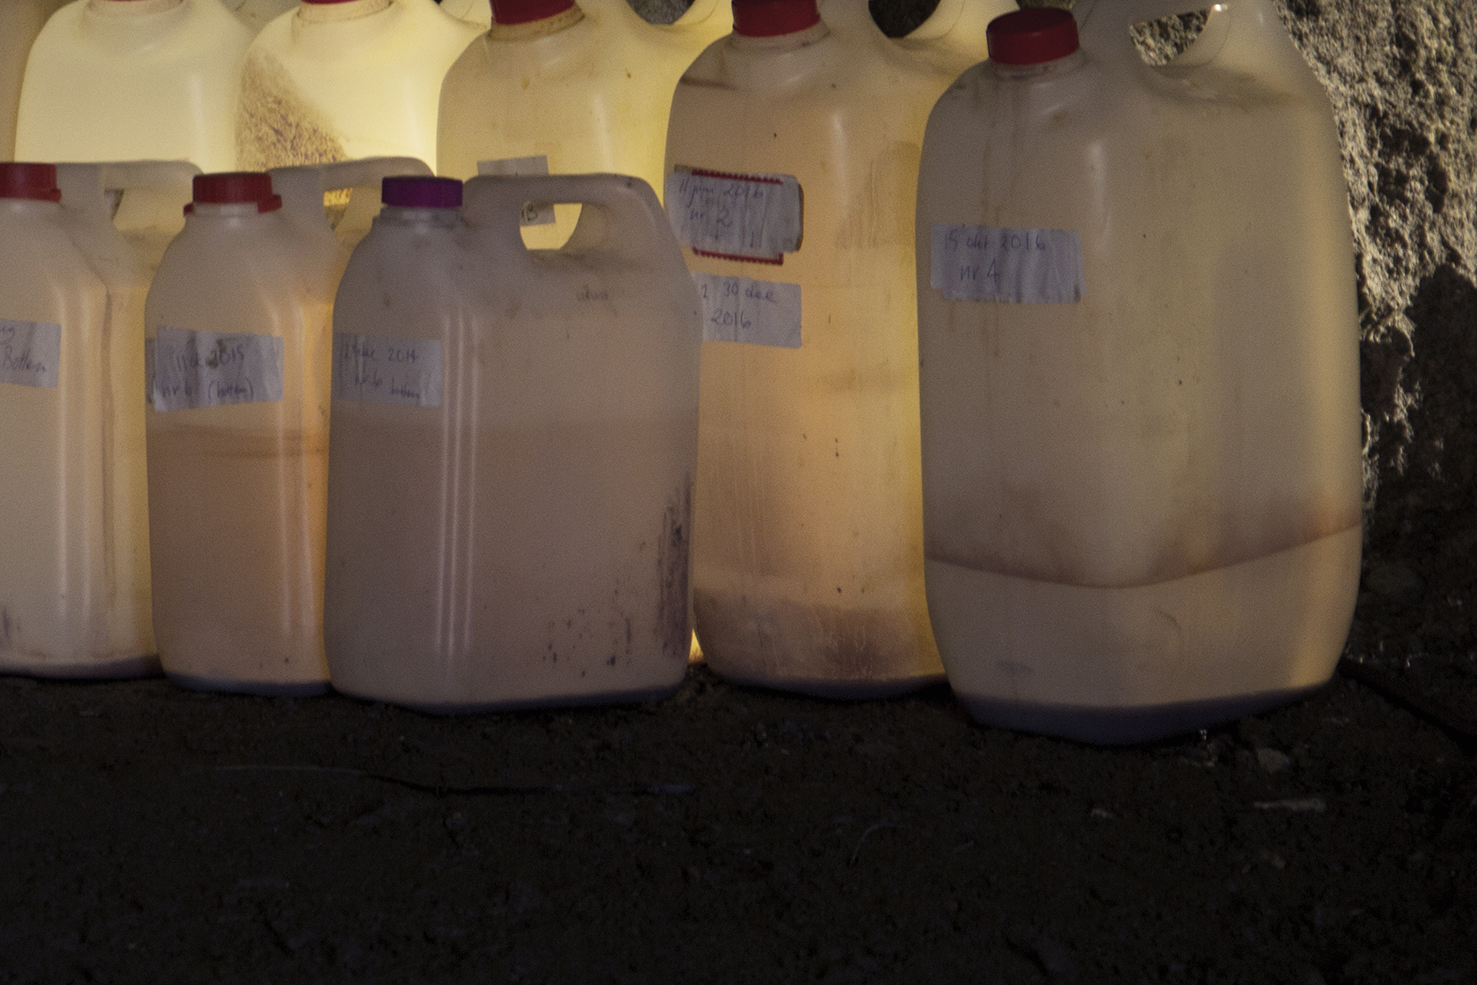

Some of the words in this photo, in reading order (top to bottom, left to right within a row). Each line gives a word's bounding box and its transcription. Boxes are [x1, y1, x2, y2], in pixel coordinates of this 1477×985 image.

[1001, 233, 1046, 251] 2016
[986, 258, 998, 283] 4
[711, 308, 752, 328] 2016
